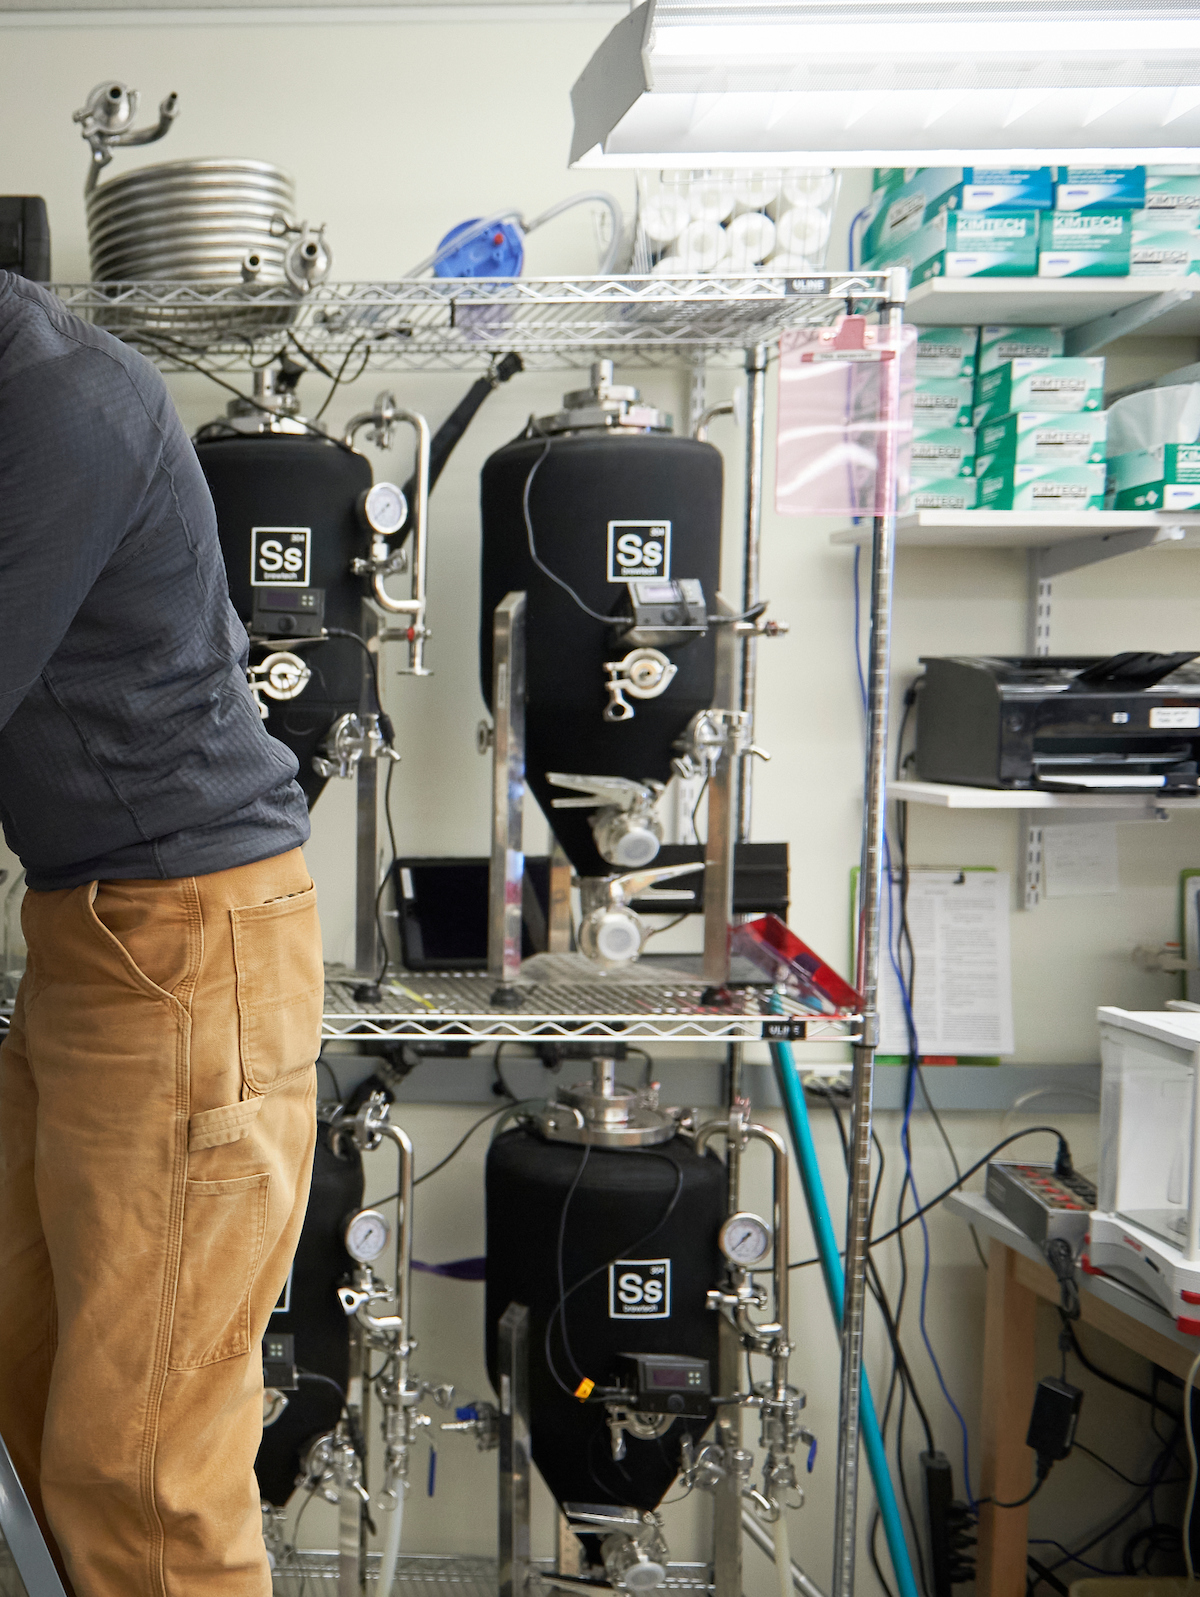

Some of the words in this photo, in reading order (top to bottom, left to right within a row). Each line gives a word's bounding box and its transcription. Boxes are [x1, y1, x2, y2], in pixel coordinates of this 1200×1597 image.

[956, 218, 1027, 231] KIMTECH
[1053, 216, 1124, 229] KIMTECH
[792, 279, 825, 292] ULINE
[1030, 378, 1087, 387] KIMTECH
[1035, 432, 1091, 441] KIMTECH
[1032, 485, 1088, 494] KIMTECH
[259, 539, 303, 572] Ss
[615, 533, 664, 568] Ss
[617, 1272, 664, 1305] Ss
